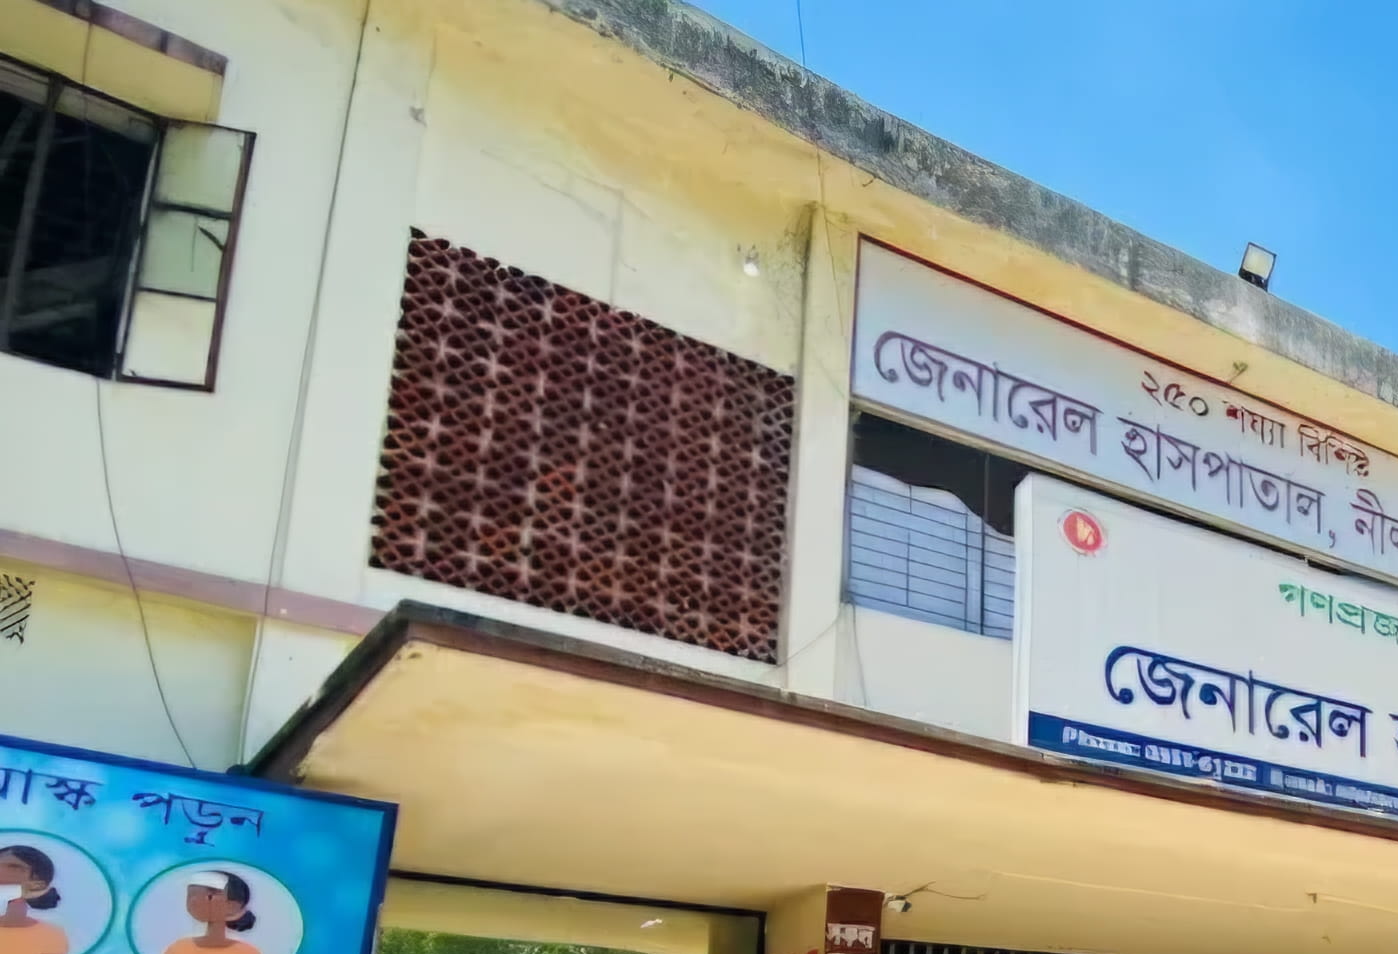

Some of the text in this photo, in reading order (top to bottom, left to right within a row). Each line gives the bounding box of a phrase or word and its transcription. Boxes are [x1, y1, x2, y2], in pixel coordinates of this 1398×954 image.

[873, 330, 1103, 456] জেনারেল
[1116, 414, 1337, 549] হাসপাতাল,
[1141, 371, 1209, 416] ২৫০
[1103, 644, 1374, 759] জেনারেল
